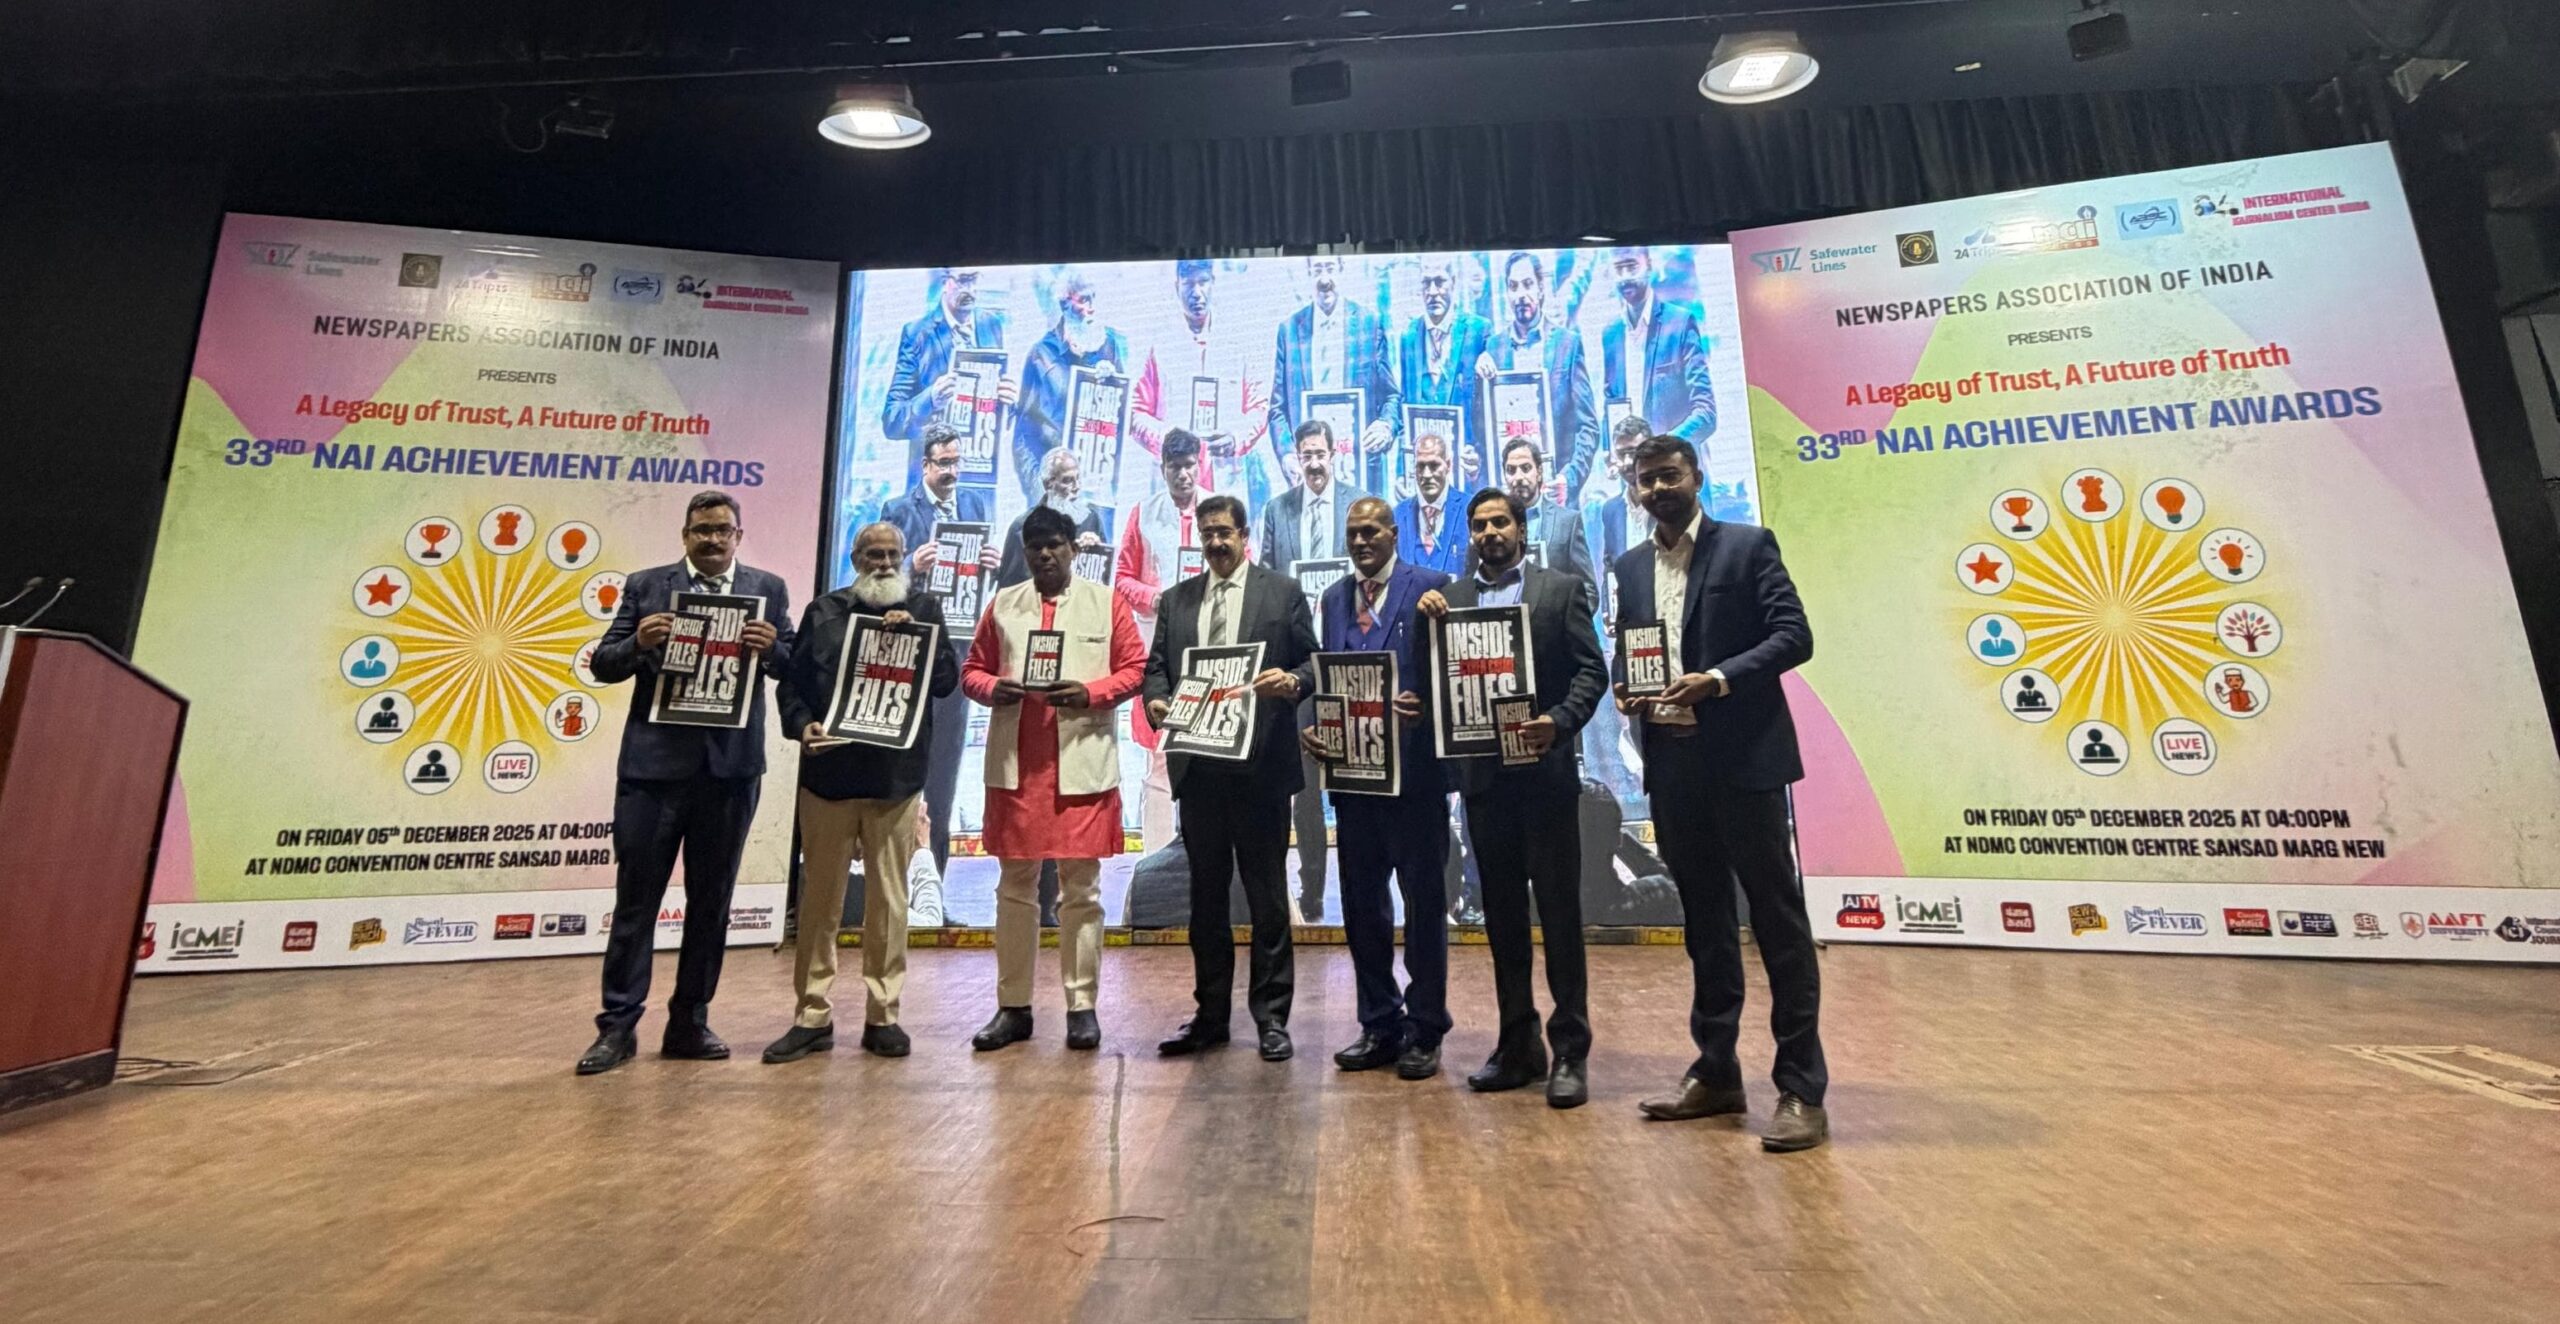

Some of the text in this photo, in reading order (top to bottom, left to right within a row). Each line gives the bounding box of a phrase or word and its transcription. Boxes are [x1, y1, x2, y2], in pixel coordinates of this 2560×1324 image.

[2242, 185, 2346, 210] INTERNATIONAL
[1809, 243, 1878, 261] Safewater
[1811, 260, 1847, 274] Lines
[1836, 260, 2274, 328] NEWSPAPERS ASSOCIATION OF INDIA
[314, 316, 720, 360] NEWSPAPERS ASSOCIATION OF INDIA
[2007, 326, 2093, 346] PRESENTS
[478, 369, 557, 384] PRESENTS
[1846, 342, 2292, 408] A Legacy of Trust, A Future of Truth
[295, 394, 711, 436] A Legacy of Trust, A Future of Truth
[1796, 386, 2385, 462] 33RD NAI ACHIEVEMENT AWARDS
[223, 438, 766, 488] 33RD NAI ACHIEVEMENT AWARDS
[672, 616, 707, 639] INSIDE
[1625, 626, 1663, 651] INSIDE
[856, 628, 922, 671] INSIDE
[1030, 635, 1061, 653] INSIDE
[1445, 620, 1515, 661] INSIDE
[664, 641, 701, 667] FILES
[1027, 658, 1059, 681] FILES
[1626, 655, 1665, 685] FILES
[1176, 678, 1211, 700] INSIDE
[1328, 664, 1385, 704] INSIDE
[843, 676, 913, 726] FILES
[1168, 700, 1201, 723] FILES
[1496, 701, 1532, 724] INSIDE
[1347, 716, 1386, 767] LES
[2166, 737, 2202, 750] LIVE
[497, 759, 528, 770] LIVE
[2171, 752, 2202, 760] NEWS
[497, 771, 525, 780] NEWS
[1963, 807, 2351, 828] ON FRIDAY 05th DECEMBER 2025 AT 04:00PM
[276, 821, 617, 847] ON FRIDAY 05th DECEMBER 2025 AT 04:00P
[1944, 836, 2387, 858] AT NDMC CONVENTION CENTRE SANSAD MARG NEW
[245, 857, 268, 876] AT
[269, 856, 322, 875] NDMC
[324, 853, 431, 873] CONVENTION
[432, 852, 495, 871] CENTRE
[497, 850, 561, 869] SANSAD
[564, 848, 611, 867] MARG
[1845, 914, 1879, 925] NEWS
[2148, 916, 2203, 930] FEVER
[2427, 912, 2487, 927] AAFT
[425, 925, 475, 939] FEVER
